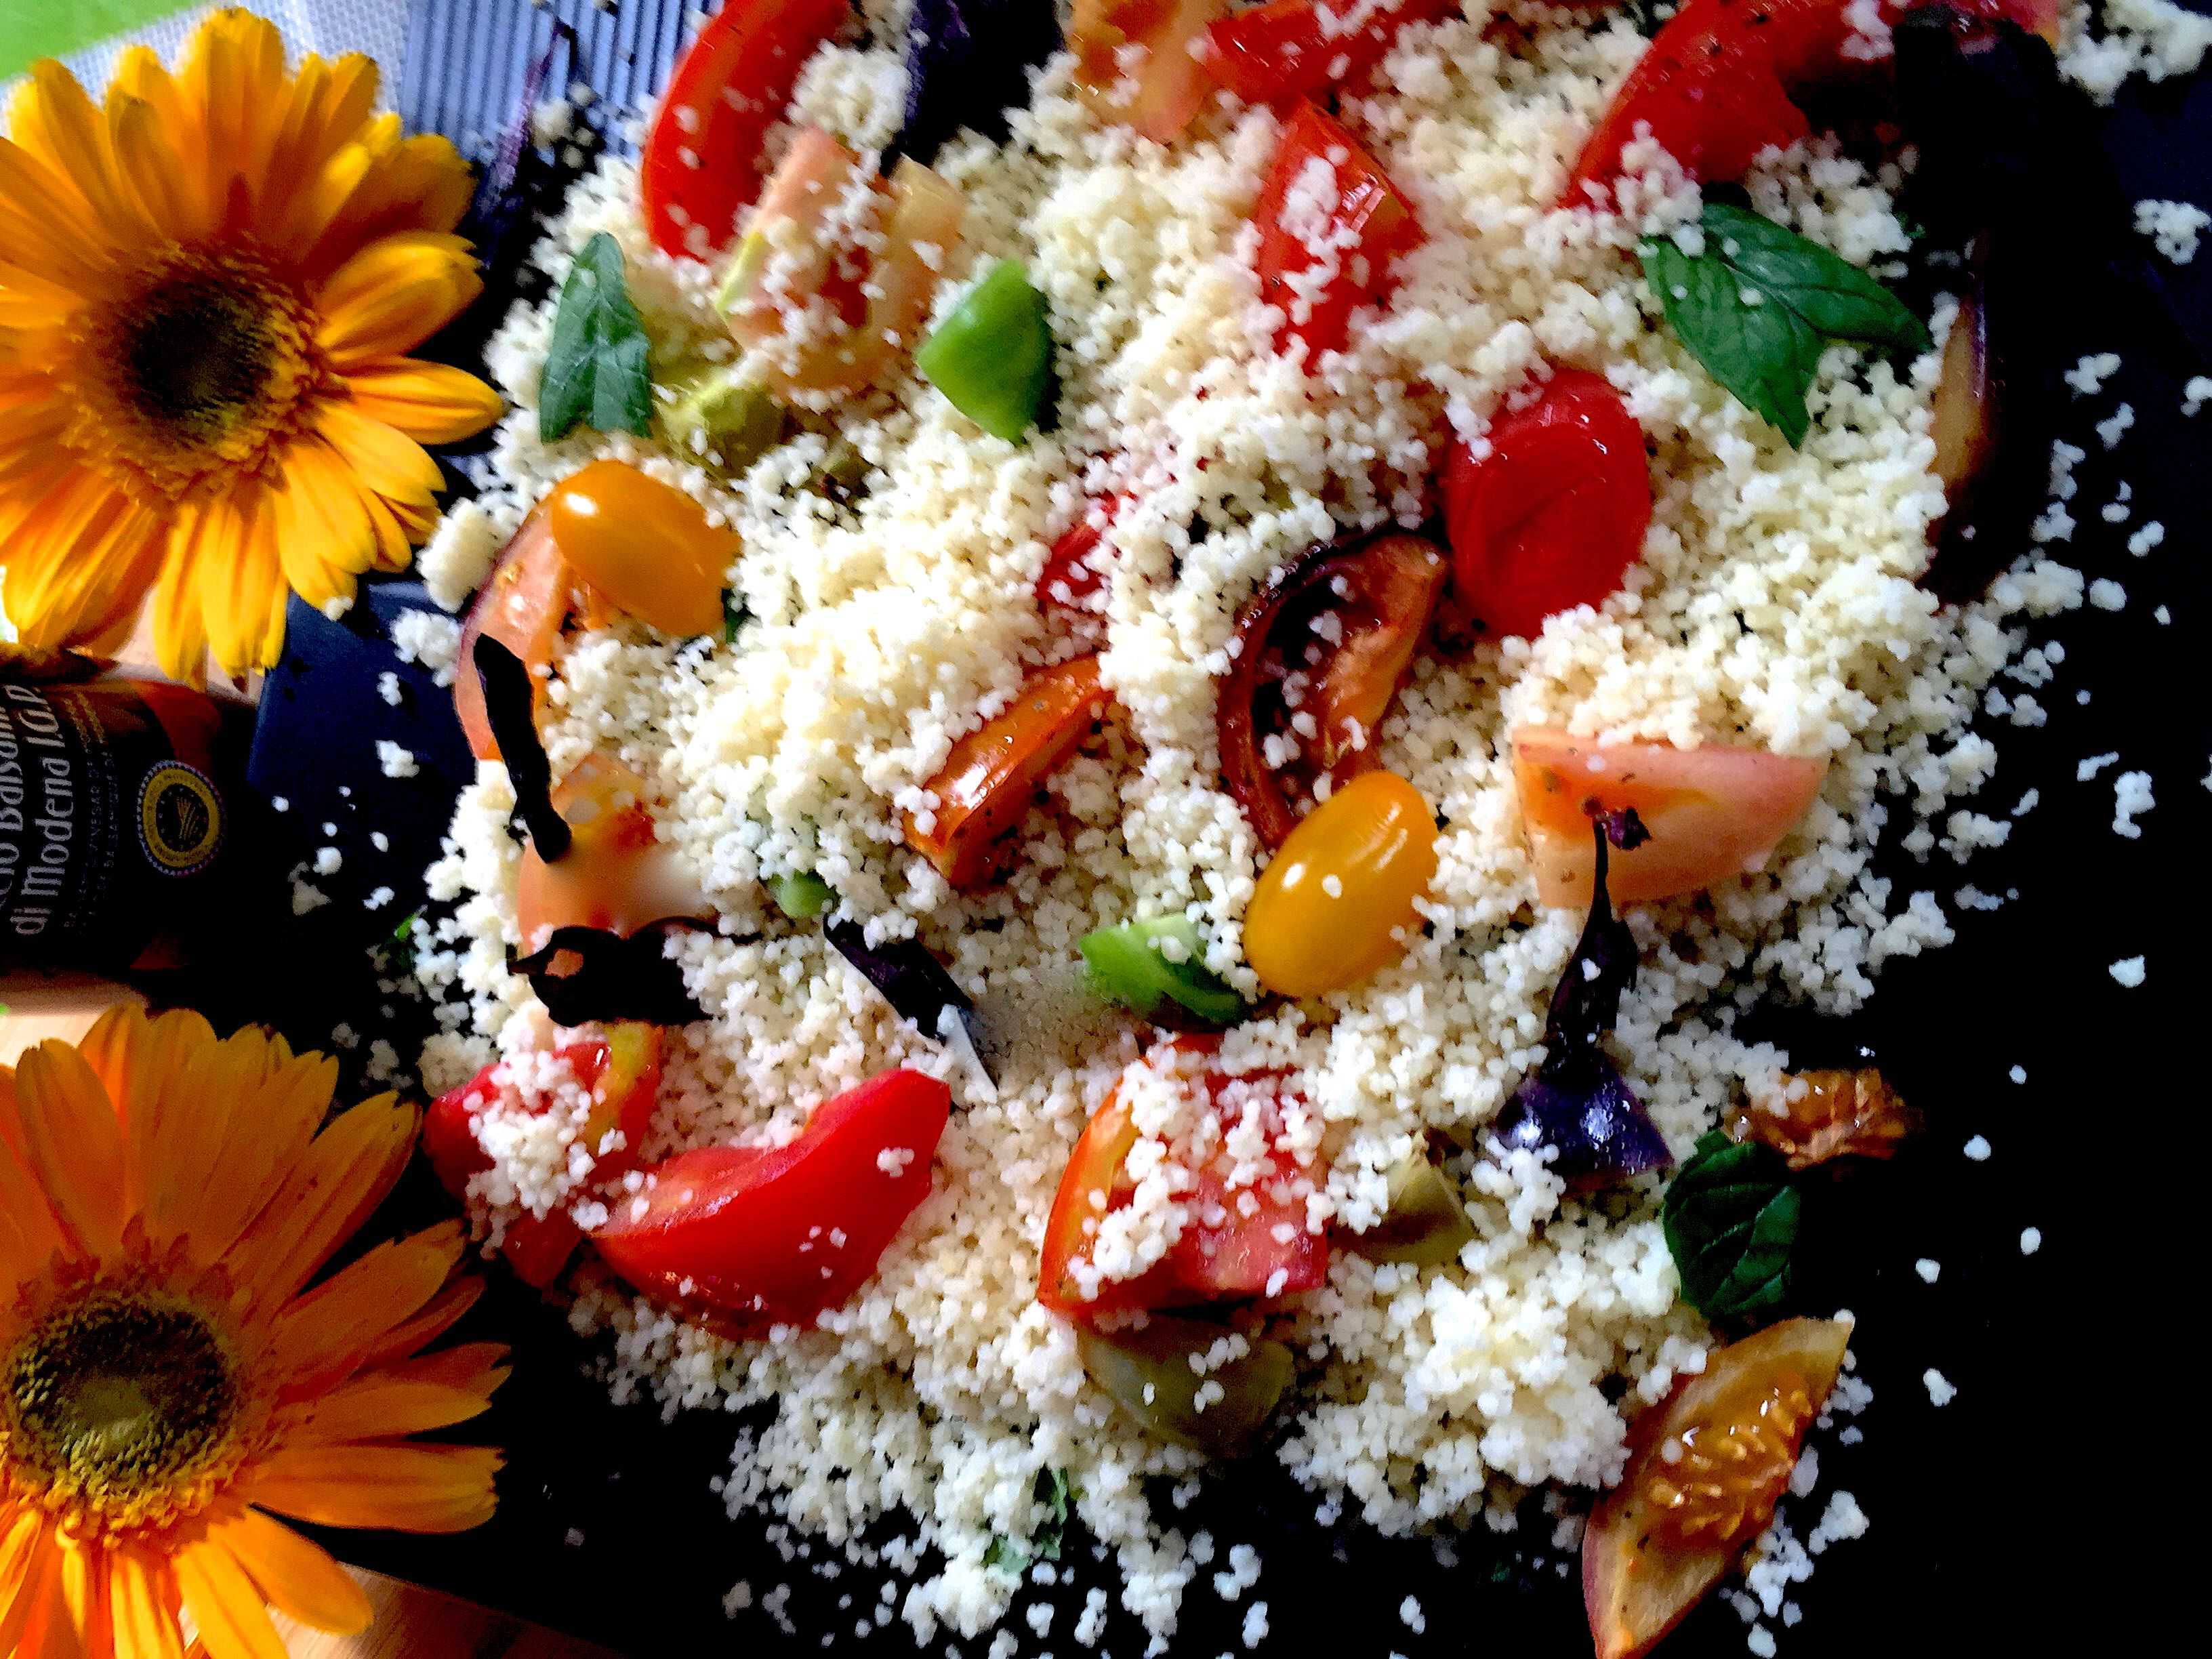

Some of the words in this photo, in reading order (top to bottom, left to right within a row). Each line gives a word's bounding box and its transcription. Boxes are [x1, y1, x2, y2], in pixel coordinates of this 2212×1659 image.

[0, 705, 24, 832] Balsa
[20, 756, 74, 897] Modena
[11, 905, 54, 936] di
